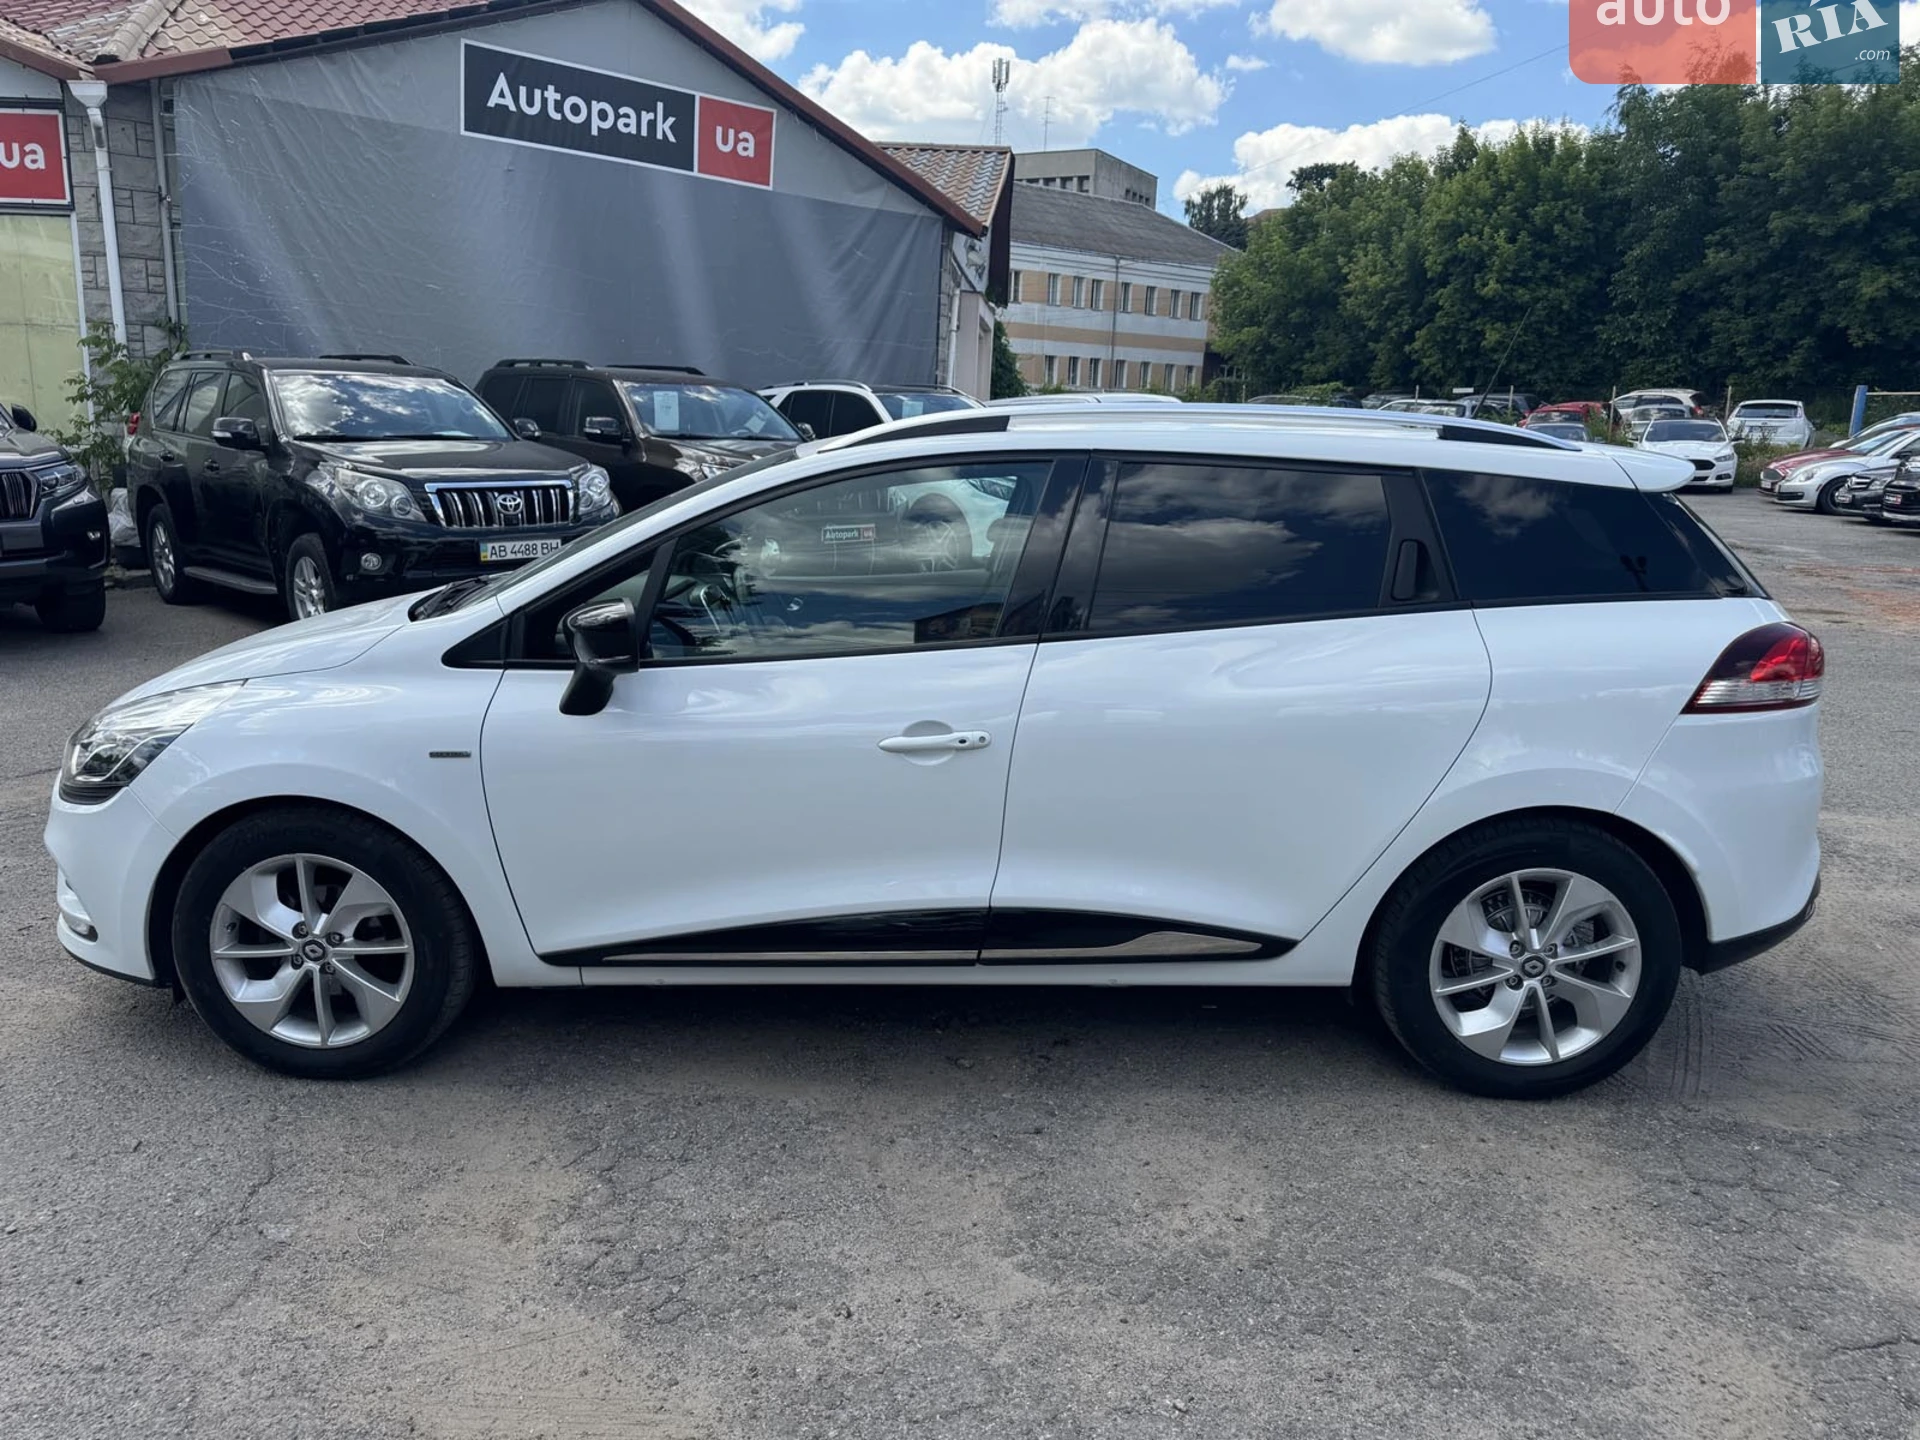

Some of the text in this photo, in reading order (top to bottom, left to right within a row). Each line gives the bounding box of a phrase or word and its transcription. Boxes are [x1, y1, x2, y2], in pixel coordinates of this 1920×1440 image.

[487, 72, 755, 158] Autopark ua
[0, 142, 46, 170] ua
[825, 529, 858, 540] Autopark
[490, 545, 507, 558] AB
[510, 543, 538, 556] 4488
